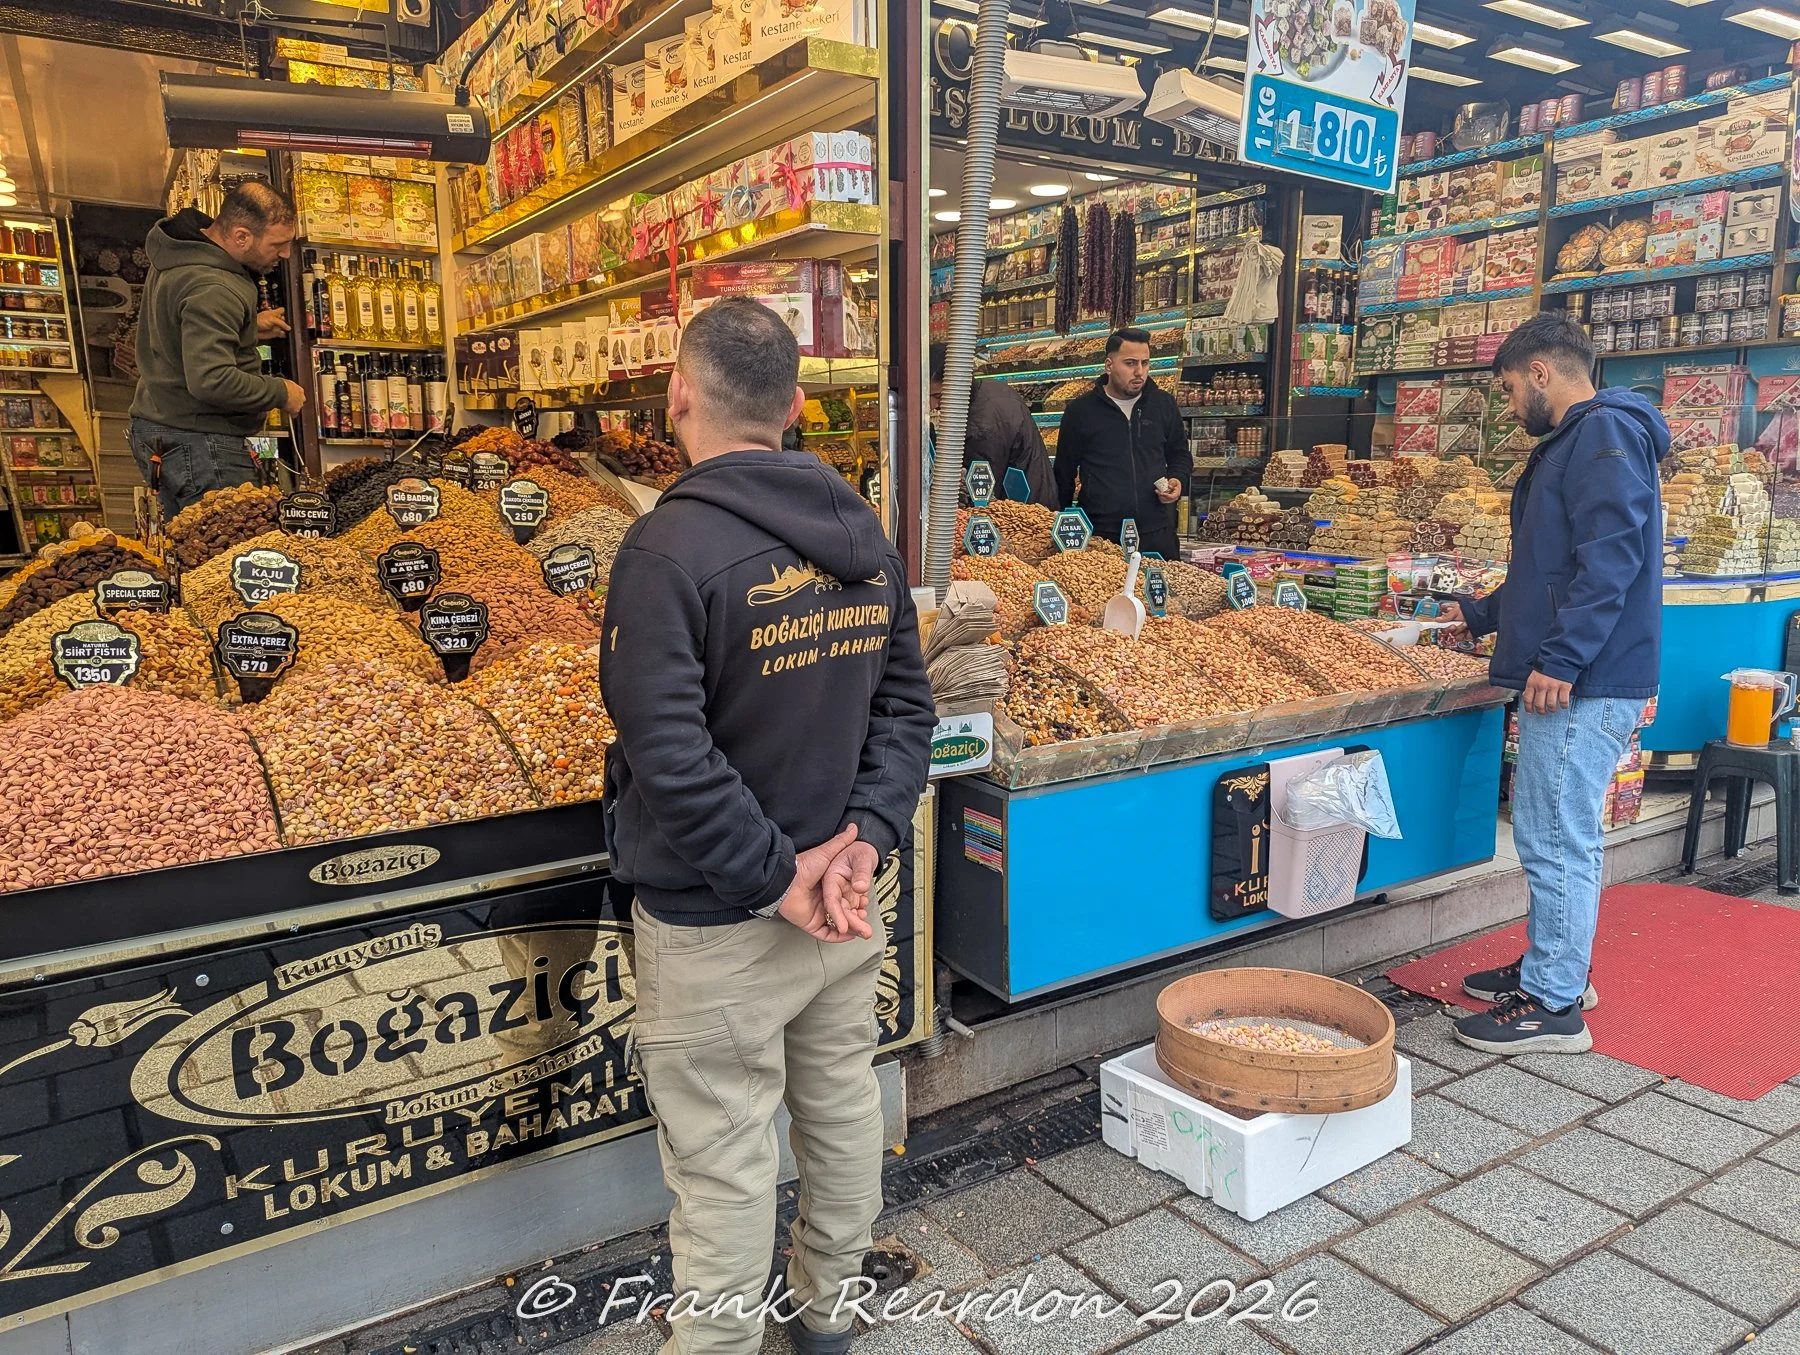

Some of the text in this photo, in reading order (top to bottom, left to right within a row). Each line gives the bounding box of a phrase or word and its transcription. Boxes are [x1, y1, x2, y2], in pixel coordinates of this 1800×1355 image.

[760, 19, 801, 38] Kestane
[1258, 28, 1277, 70] KAMPANYA
[1378, 67, 1400, 99] KAMPANYA
[650, 95, 680, 109] Kestane
[618, 116, 645, 131] Kestane
[1255, 86, 1276, 150] 1 KG
[1005, 106, 1142, 149] LOKUM
[1286, 109, 1370, 164] 180
[720, 284, 745, 293] TURKISH
[769, 282, 789, 291] HALVA
[477, 480, 496, 490] 260
[975, 487, 987, 496] 680
[393, 493, 432, 503] ÇİĞ BADEM
[286, 508, 329, 519] LÜKS CEVİZ
[401, 512, 423, 522] 680
[515, 512, 533, 521] 250
[1065, 539, 1079, 547] 590
[251, 567, 284, 580] KAJU
[390, 563, 429, 573] BADEM
[401, 580, 425, 593] 680
[563, 577, 585, 592] 480
[106, 589, 160, 599] SPECIAL ÇEREZ
[250, 588, 277, 600] 620
[430, 612, 478, 625] KINA ÇEREZİ
[750, 607, 824, 650] BOĞAZİÇİ
[231, 634, 287, 647] EXTRA ÇEREZ
[445, 637, 468, 649] 320
[610, 625, 619, 652] 1
[65, 646, 127, 657] SİİRT FISTIK
[761, 647, 819, 676] LOKUM
[829, 636, 887, 658] BAHARAT
[240, 660, 268, 672] 570
[74, 666, 111, 682] 1350
[280, 925, 440, 984] Kuruyemiş
[231, 938, 624, 1101] Boğaziçi
[388, 1036, 602, 1121] Lokum & Baharat
[264, 1086, 636, 1221] LOKUM & BAHARAT
